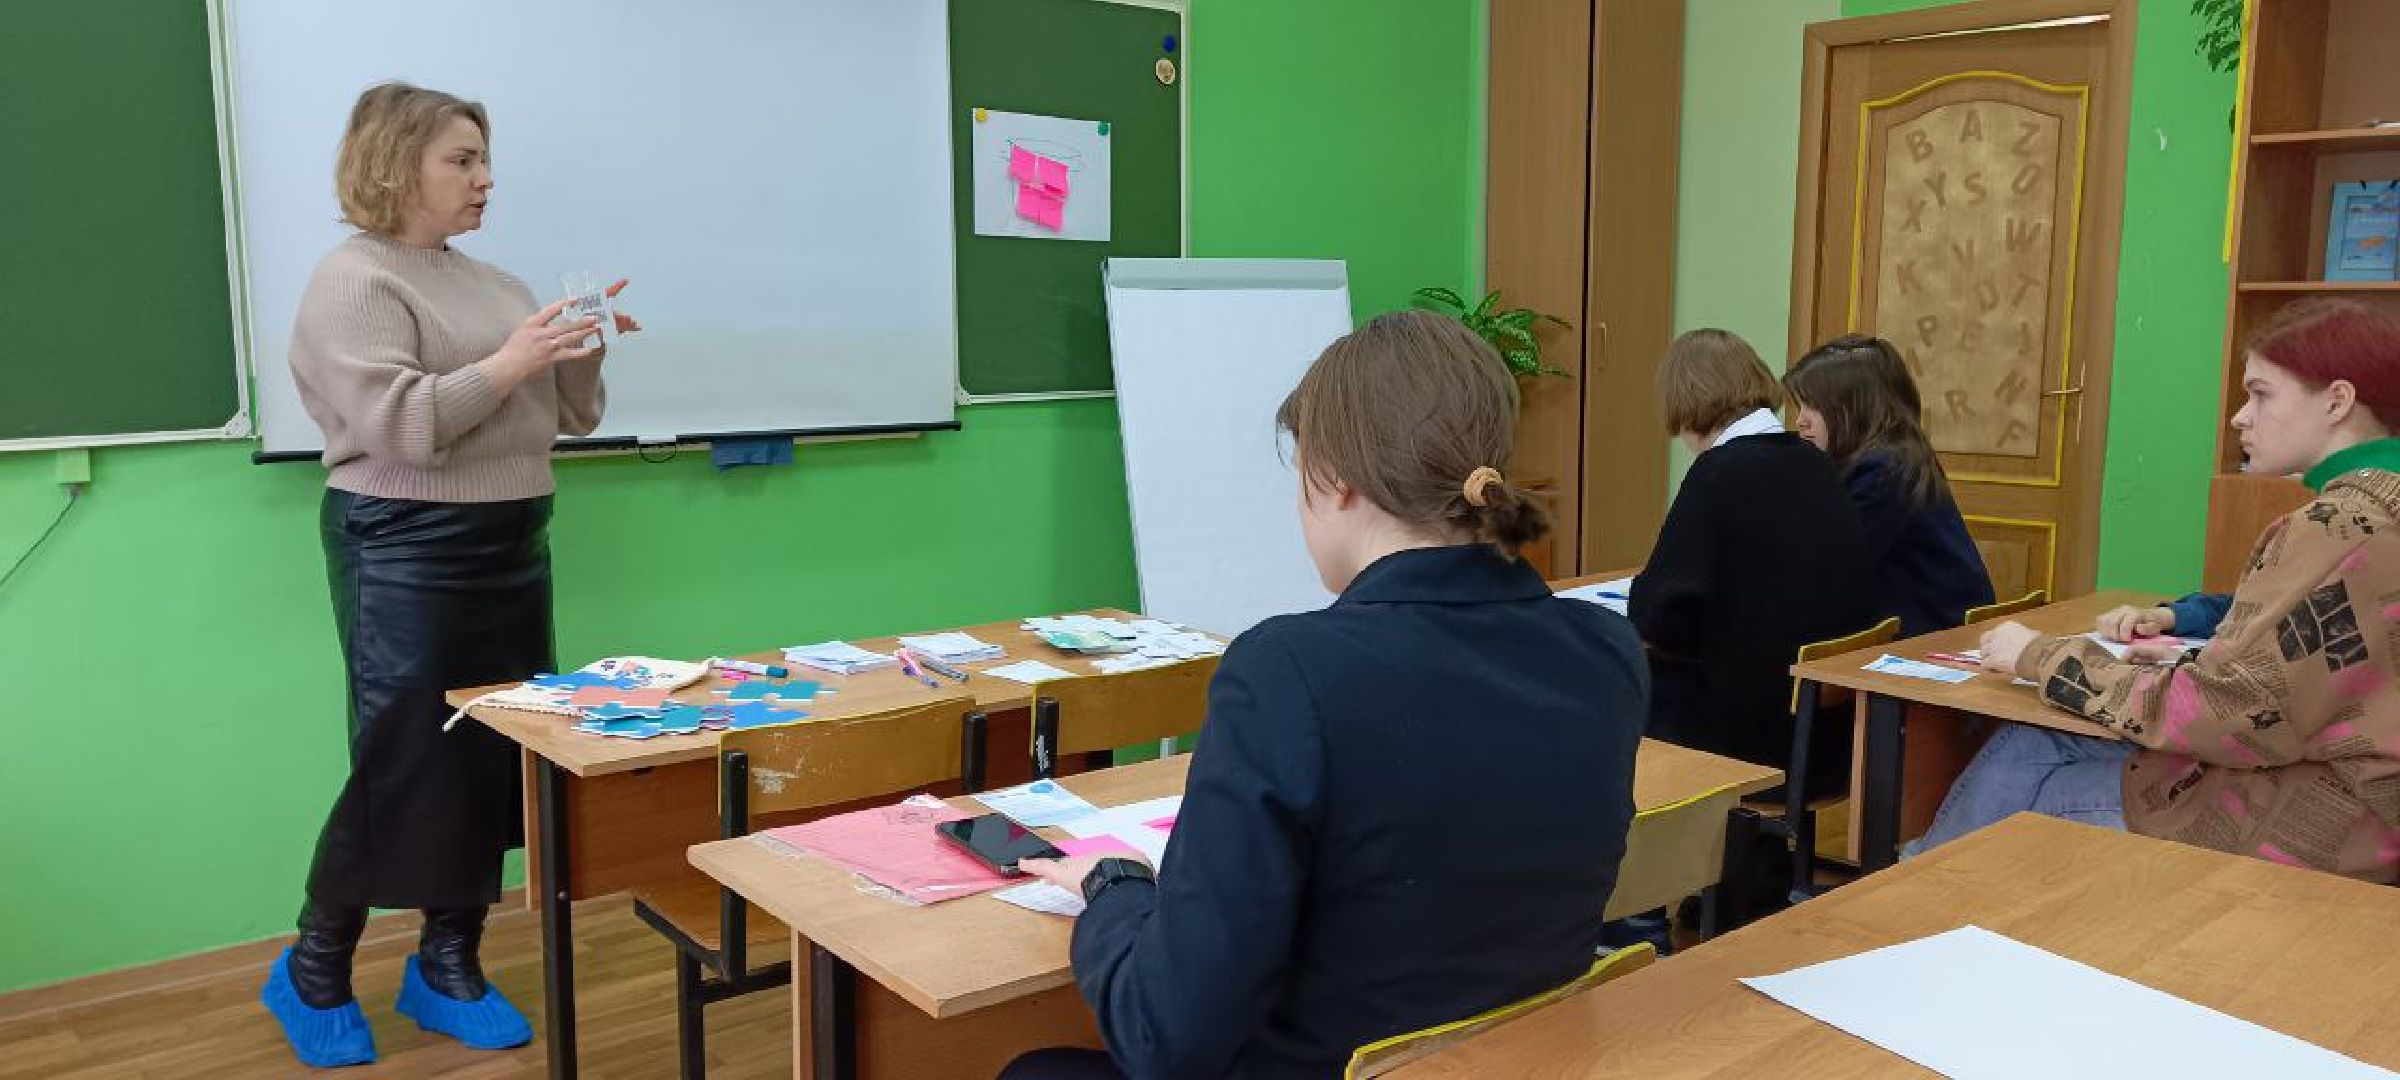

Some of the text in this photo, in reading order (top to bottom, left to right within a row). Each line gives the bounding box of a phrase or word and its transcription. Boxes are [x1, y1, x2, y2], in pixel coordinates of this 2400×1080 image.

[1960, 110, 1983, 143] A
[2010, 121, 2041, 156] Z
[1905, 130, 1933, 163] B
[1923, 171, 1947, 210] Y
[1963, 171, 1987, 206] S
[1899, 196, 1927, 233] X
[2005, 217, 2042, 255] W
[2011, 271, 2041, 308] T
[1916, 314, 1939, 348] P
[1944, 388, 1976, 424] R
